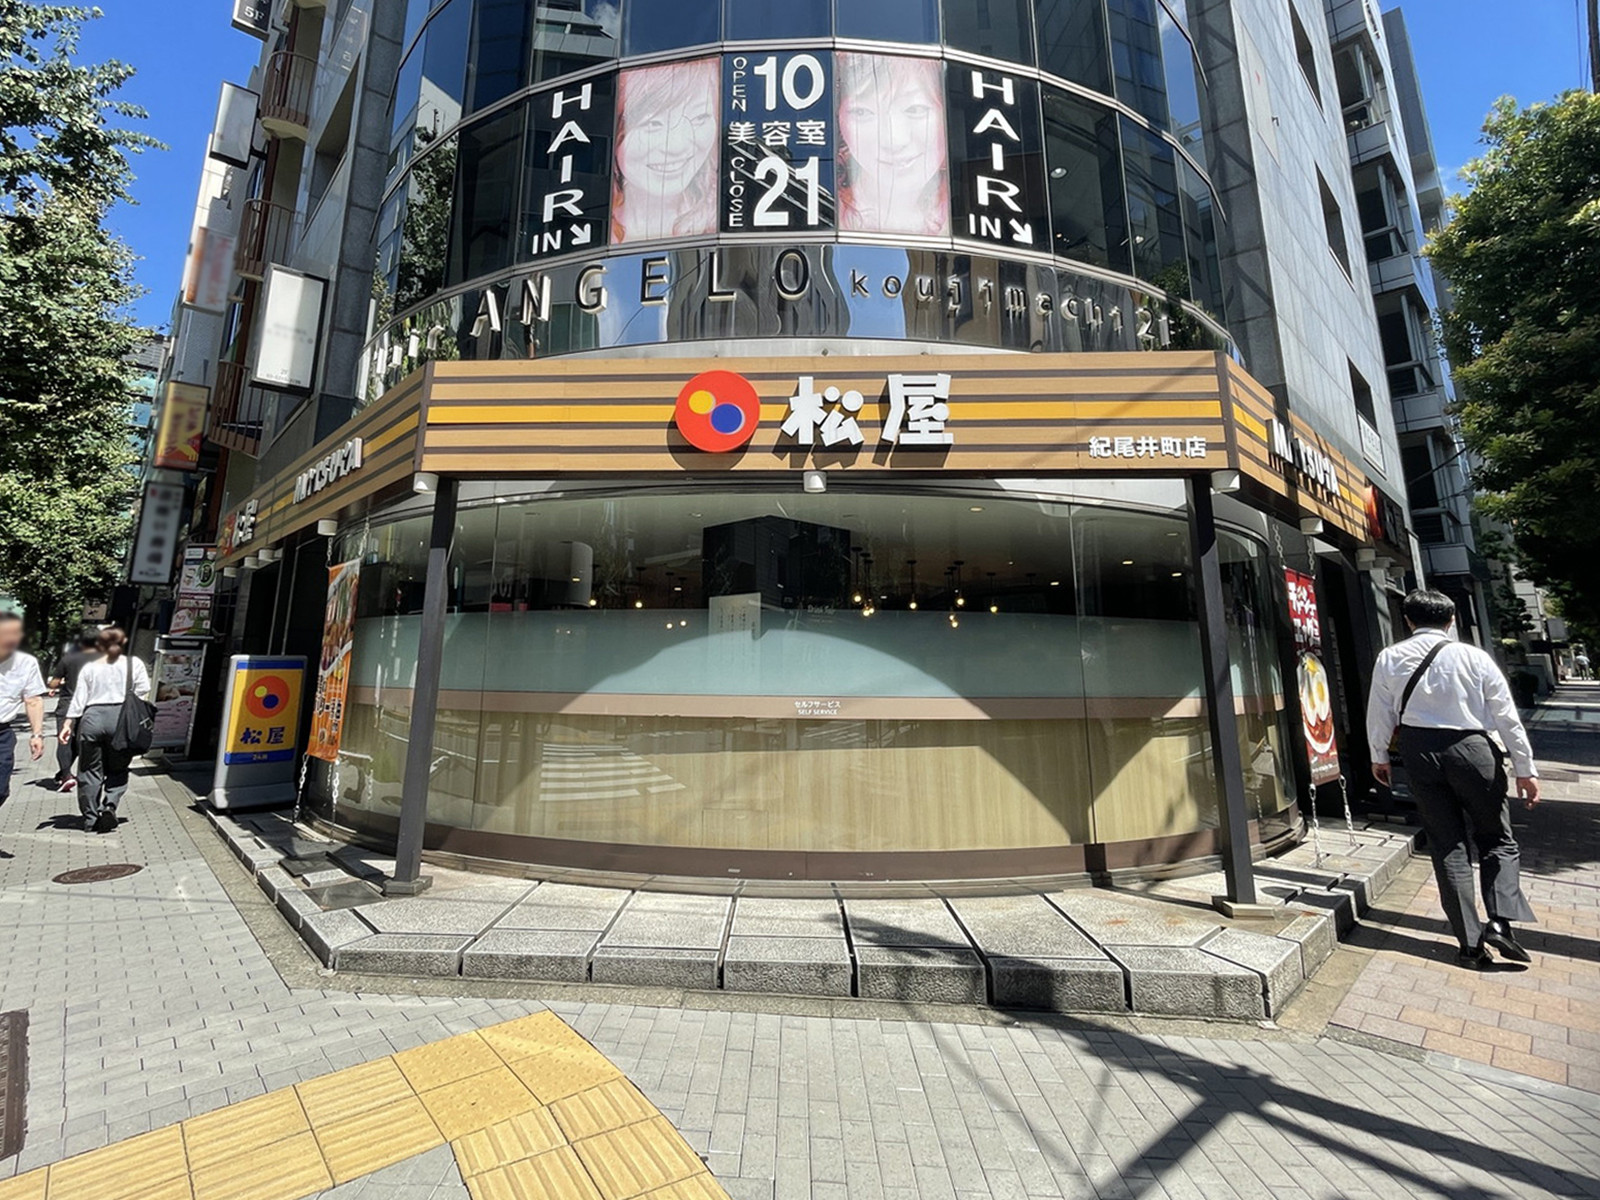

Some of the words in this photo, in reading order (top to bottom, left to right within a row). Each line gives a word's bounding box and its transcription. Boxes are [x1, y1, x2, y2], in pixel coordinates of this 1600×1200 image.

[244, 6, 264, 20] 5F
[732, 56, 747, 112] OPEN
[754, 54, 825, 111] 10
[543, 83, 592, 223] HAIR
[728, 120, 826, 147] 美容室
[971, 71, 1023, 213] HAIR
[729, 157, 745, 227] CLOSE
[754, 156, 819, 227] 21
[532, 230, 562, 255] IN
[969, 213, 1001, 239] IN
[471, 248, 810, 337] ANGELO
[780, 373, 954, 446] 松屋
[1089, 435, 1206, 457] 紀尾井町店
[794, 700, 841, 709] セルフサービス
[240, 726, 285, 744] 松屋
